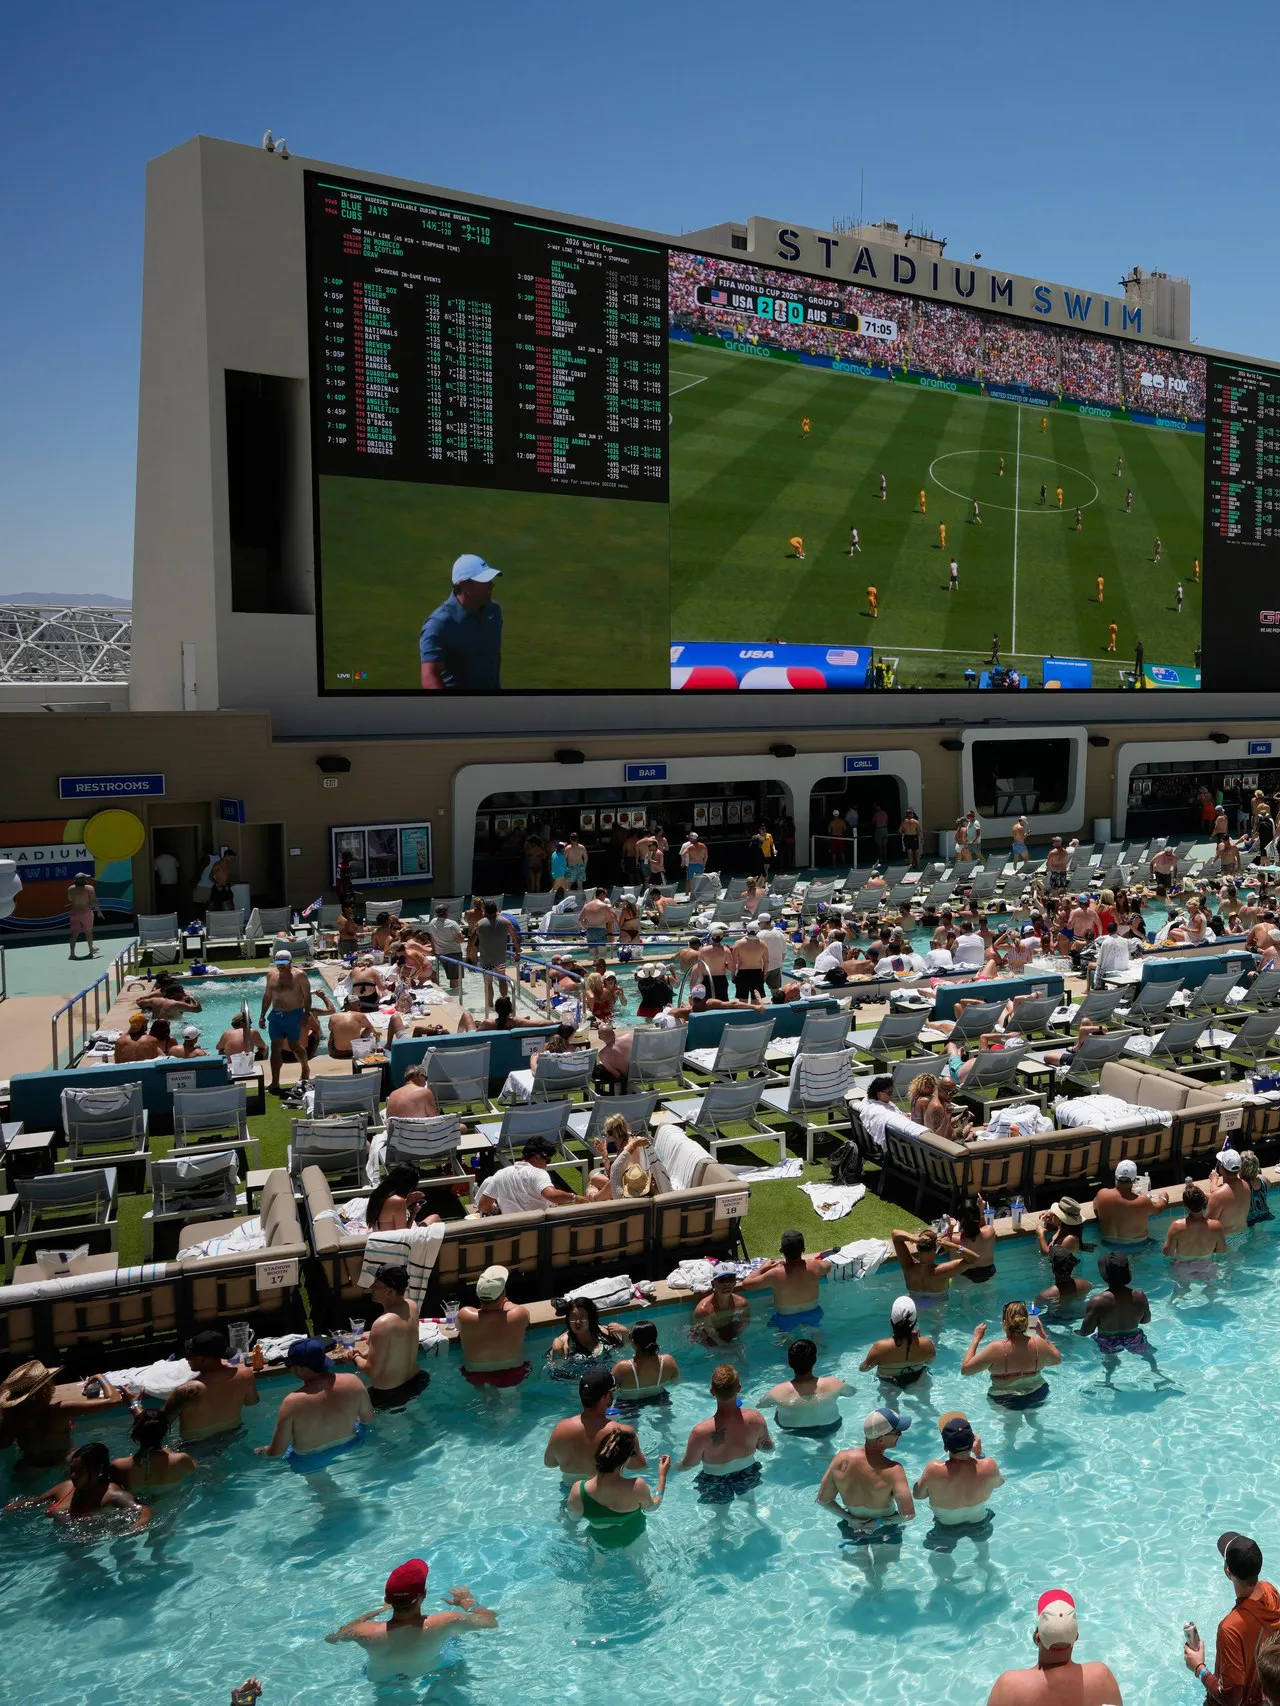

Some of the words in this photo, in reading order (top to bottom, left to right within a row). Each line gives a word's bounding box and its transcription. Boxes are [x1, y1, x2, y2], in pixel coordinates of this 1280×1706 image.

[341, 199, 362, 212] BLUE
[367, 204, 388, 216] JAYS
[341, 209, 362, 221] CUBS
[565, 237, 579, 246] 2026
[582, 240, 599, 250] World
[602, 244, 612, 252] Cup
[323, 276, 342, 286] 3:40P
[778, 228, 1013, 306] STADIUM
[1034, 285, 1143, 333] SWIM
[364, 283, 382, 292] WHITE
[324, 291, 343, 300] 4:05P
[364, 290, 386, 299] TIGERS
[719, 280, 736, 290] FIFA
[737, 282, 766, 294] WORLD
[766, 287, 781, 297] CUP
[808, 296, 832, 307] GROUP
[324, 306, 343, 315] 4:10P
[364, 304, 390, 314] YANKEES
[732, 294, 754, 309] USA
[761, 301, 770, 314] 2
[791, 306, 800, 319] 0
[806, 308, 827, 323] AUS
[364, 312, 386, 321] GIANTS
[324, 320, 344, 329] 4:10P
[364, 319, 390, 328] MARLINS
[364, 326, 397, 336] NATIONALS
[864, 321, 892, 336] 71:05
[325, 335, 344, 344] 4:15P
[365, 340, 390, 350] BREWERS
[725, 340, 770, 357] aramco
[325, 349, 344, 358] 5:05P
[365, 347, 387, 356] BRAVES
[365, 355, 387, 363] PADRES
[325, 364, 344, 372] 5:10P
[365, 362, 391, 370] RANGERS
[832, 361, 872, 376] aramco
[365, 369, 398, 379] GUARDIANS
[326, 378, 345, 387] 5:15P
[366, 376, 387, 384] ASTROS
[920, 376, 957, 391] aramco
[1168, 374, 1189, 393] FOX
[366, 383, 398, 393] CARDINALS
[326, 393, 345, 401] 6:40P
[366, 390, 388, 398] ROYALS
[990, 391, 1005, 400] UNITED
[1006, 393, 1022, 402] STATES
[1029, 397, 1048, 406] AMERICA
[366, 398, 388, 406] ANGELS
[326, 407, 346, 415] 6:45P
[366, 404, 399, 413] ATHLETICS
[1079, 405, 1111, 417] aramco
[1156, 418, 1186, 429] aramco
[367, 432, 396, 441] MARINERS
[367, 440, 392, 448] ORIOLES
[739, 649, 774, 659] USA
[76, 781, 150, 792] RESTROOMS
[726, 1206, 737, 1214] 18
[271, 1275, 284, 1284] 17
